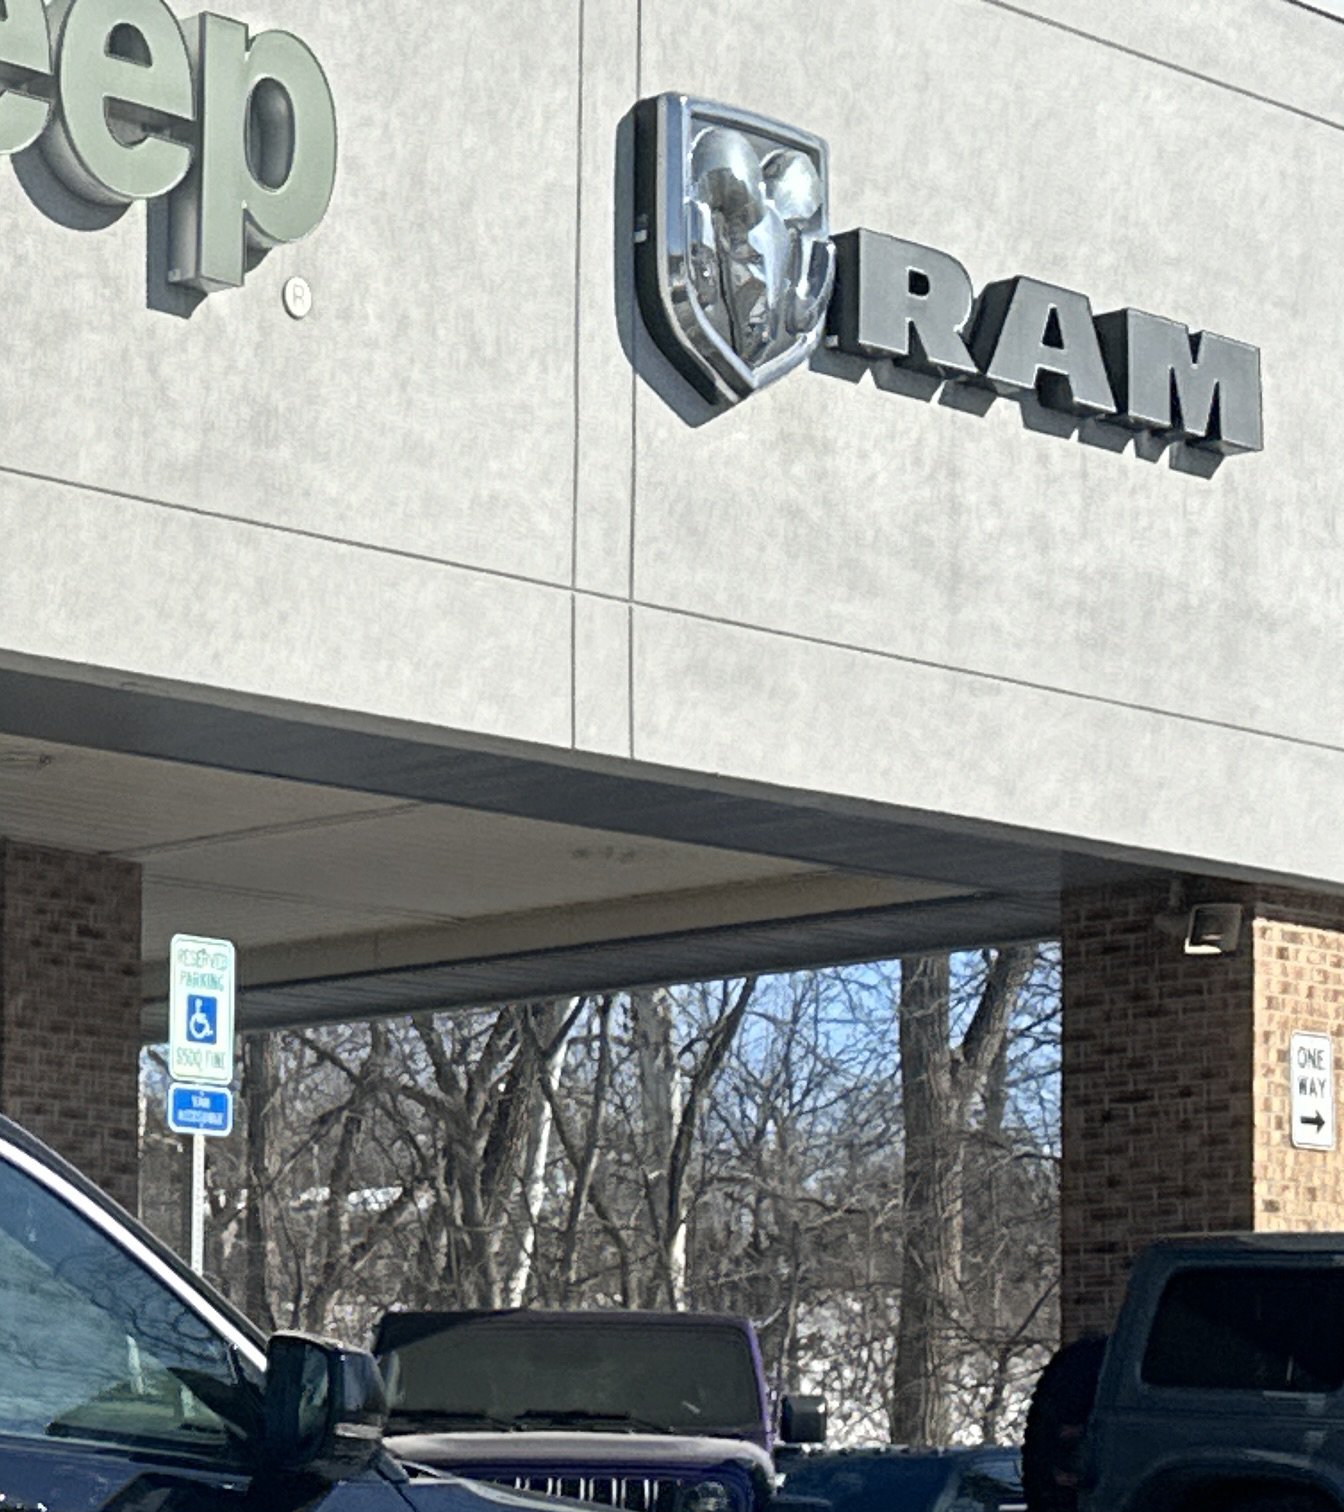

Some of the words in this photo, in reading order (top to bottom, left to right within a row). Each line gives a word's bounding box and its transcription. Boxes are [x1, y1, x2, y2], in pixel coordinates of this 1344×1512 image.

[842, 227, 1264, 450] RAM
[179, 970, 225, 992] PARKING
[1297, 1046, 1326, 1070] ONE
[1297, 1075, 1327, 1099] WAY
